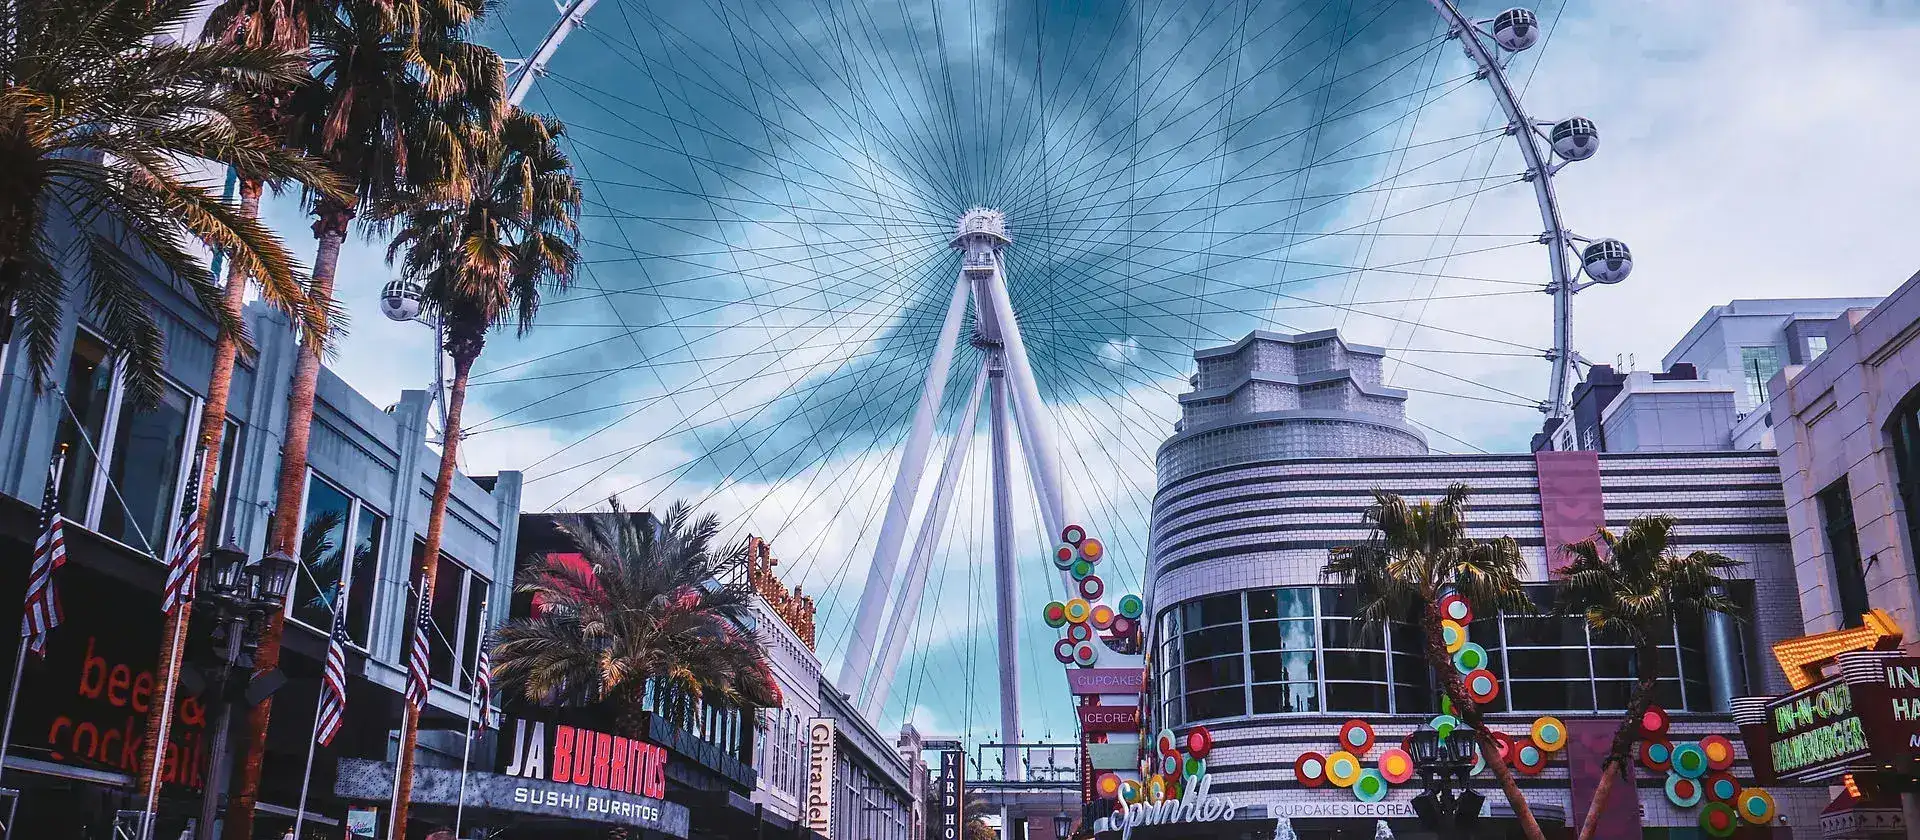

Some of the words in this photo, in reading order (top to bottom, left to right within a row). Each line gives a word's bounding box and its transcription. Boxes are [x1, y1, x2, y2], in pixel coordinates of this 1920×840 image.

[78, 635, 157, 713] bee
[1077, 675, 1143, 686] CUPCAKES
[1886, 666, 1920, 689] IN
[1084, 713, 1103, 723] ICE
[1104, 713, 1135, 723] CREA
[1770, 716, 1869, 772] HAMBURGER
[47, 714, 206, 789] cockail
[809, 723, 830, 832] Ghirardell
[514, 787, 580, 809] SUSHI
[587, 796, 658, 821] BURRITOS
[945, 753, 955, 807] YARD
[1111, 773, 1248, 840] Sprinkles
[1274, 804, 1349, 816] CUPCAKES
[1353, 804, 1375, 815] ICE
